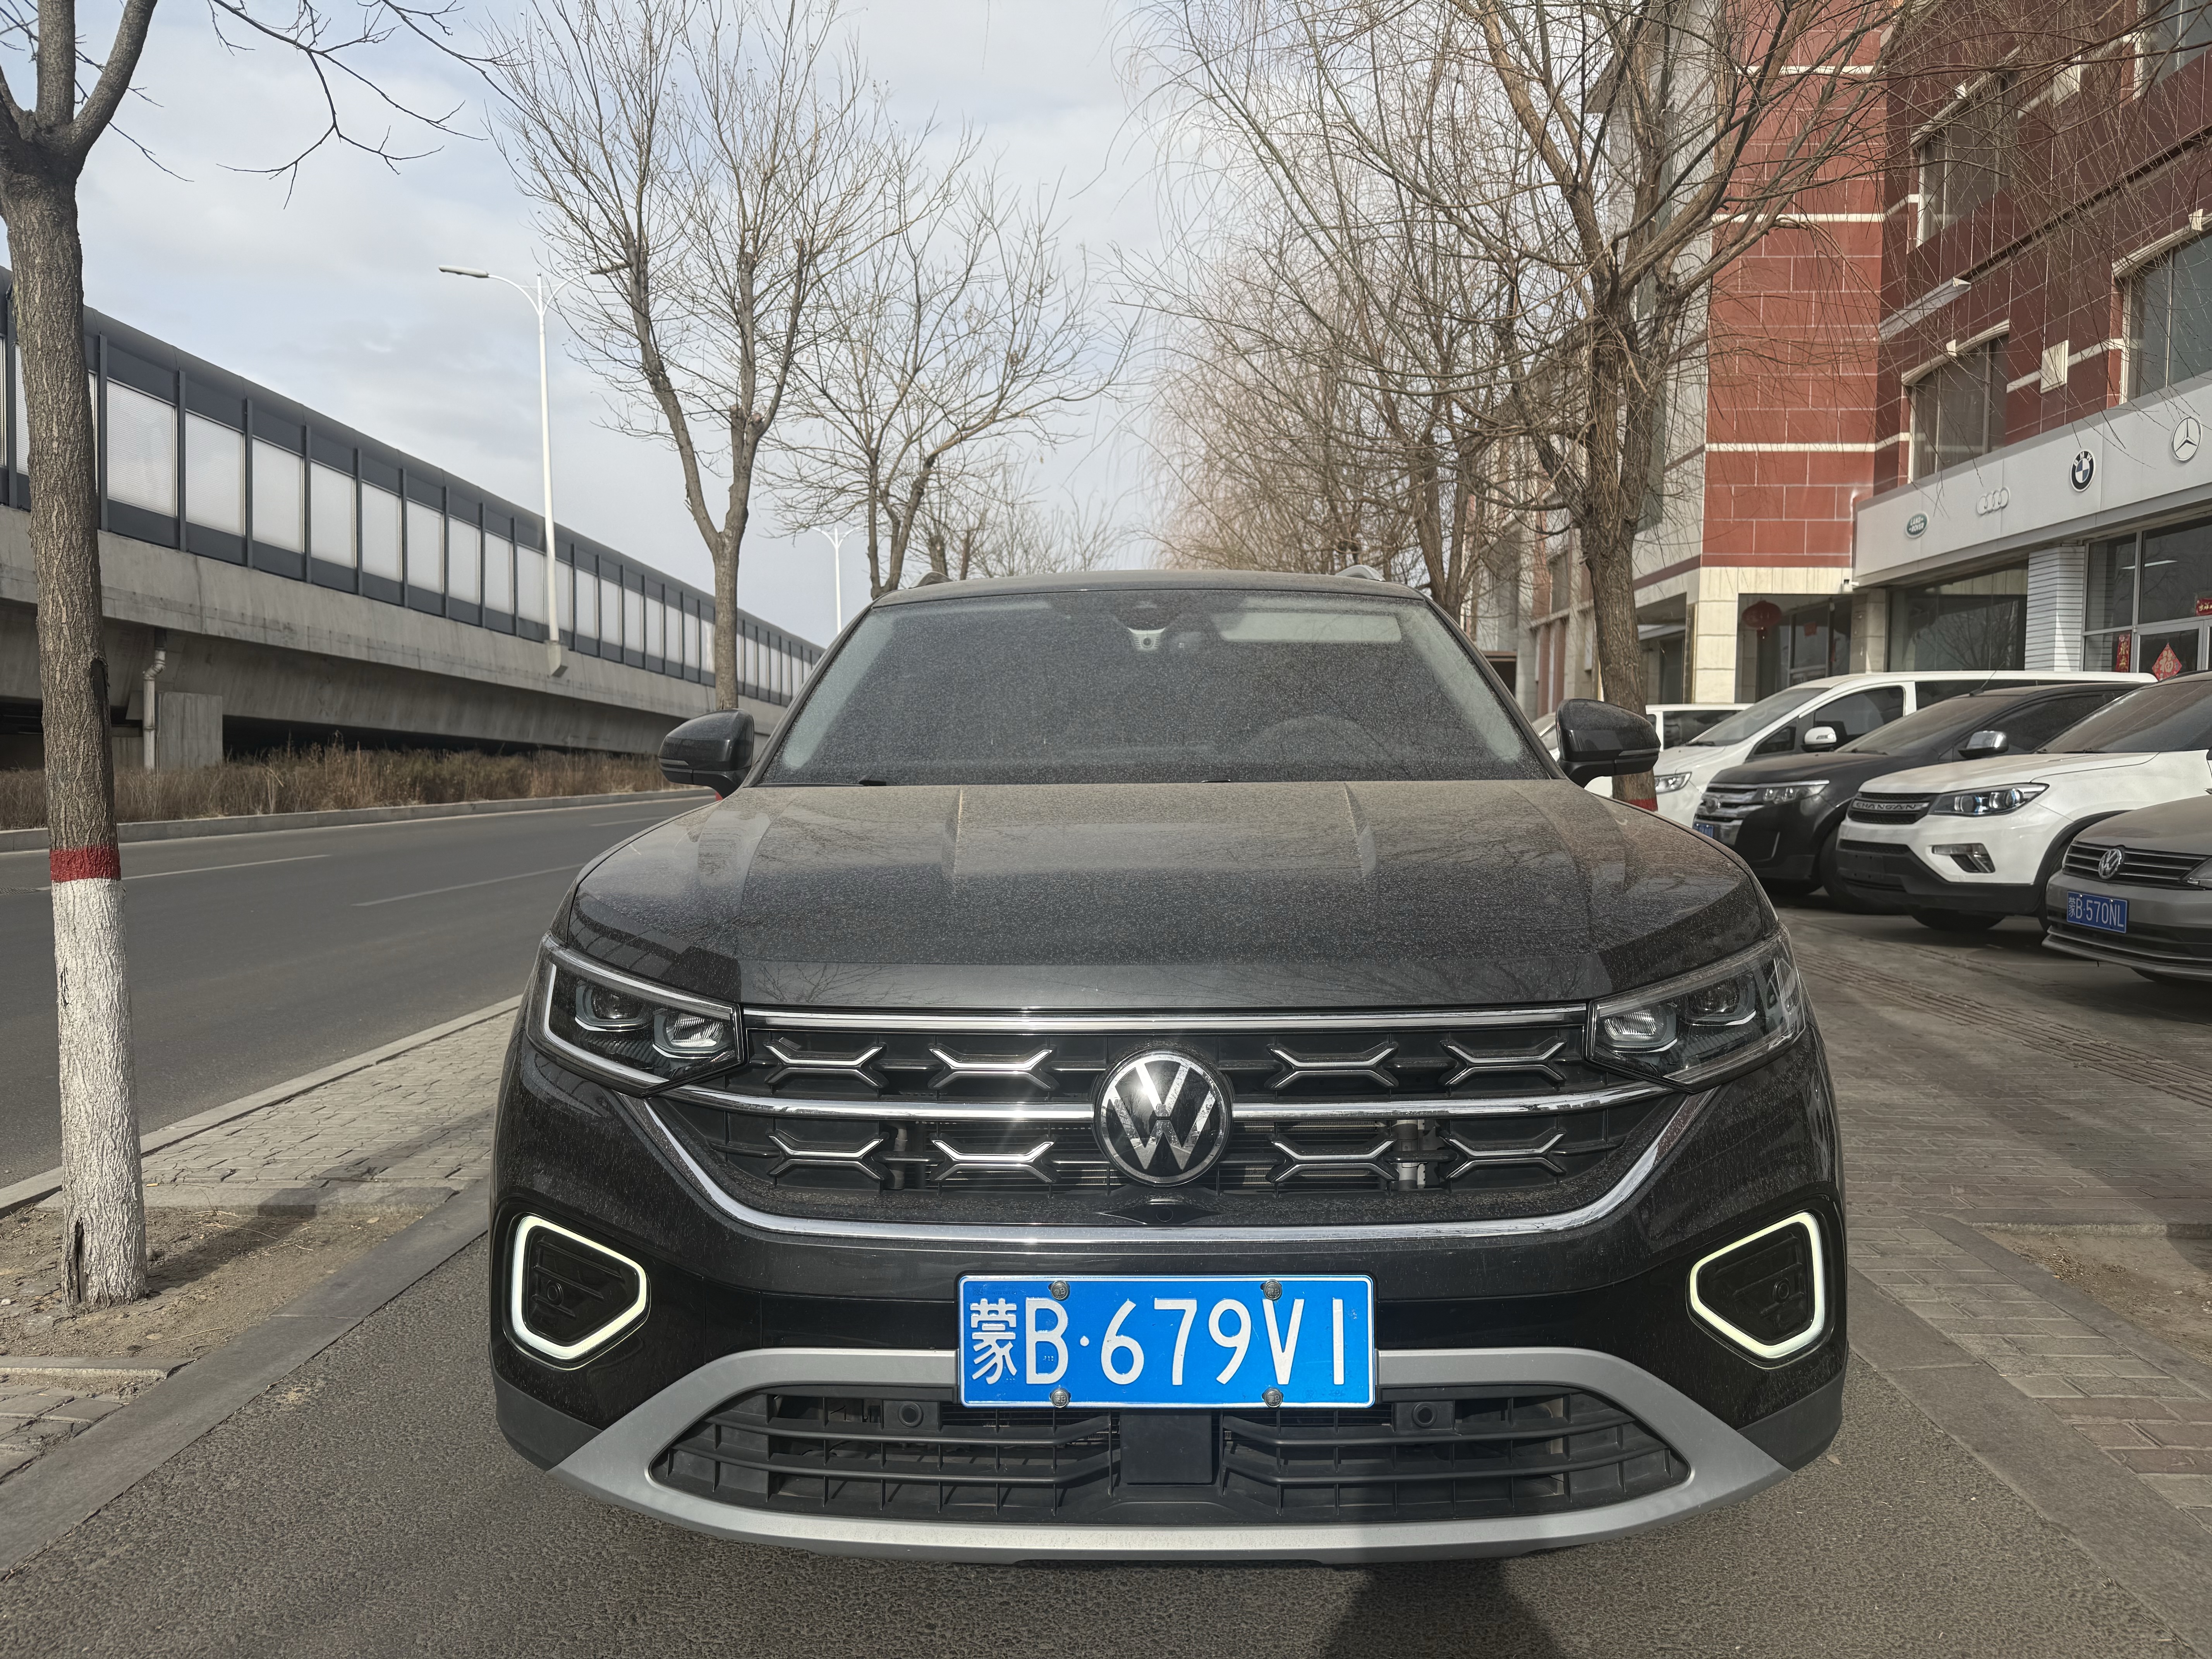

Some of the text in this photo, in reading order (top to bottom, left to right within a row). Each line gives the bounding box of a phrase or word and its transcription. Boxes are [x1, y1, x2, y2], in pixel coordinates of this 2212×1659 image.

[2073, 452, 2092, 466] BMW
[2159, 649, 2174, 673] 福
[1856, 802, 1916, 810] CHANGAN
